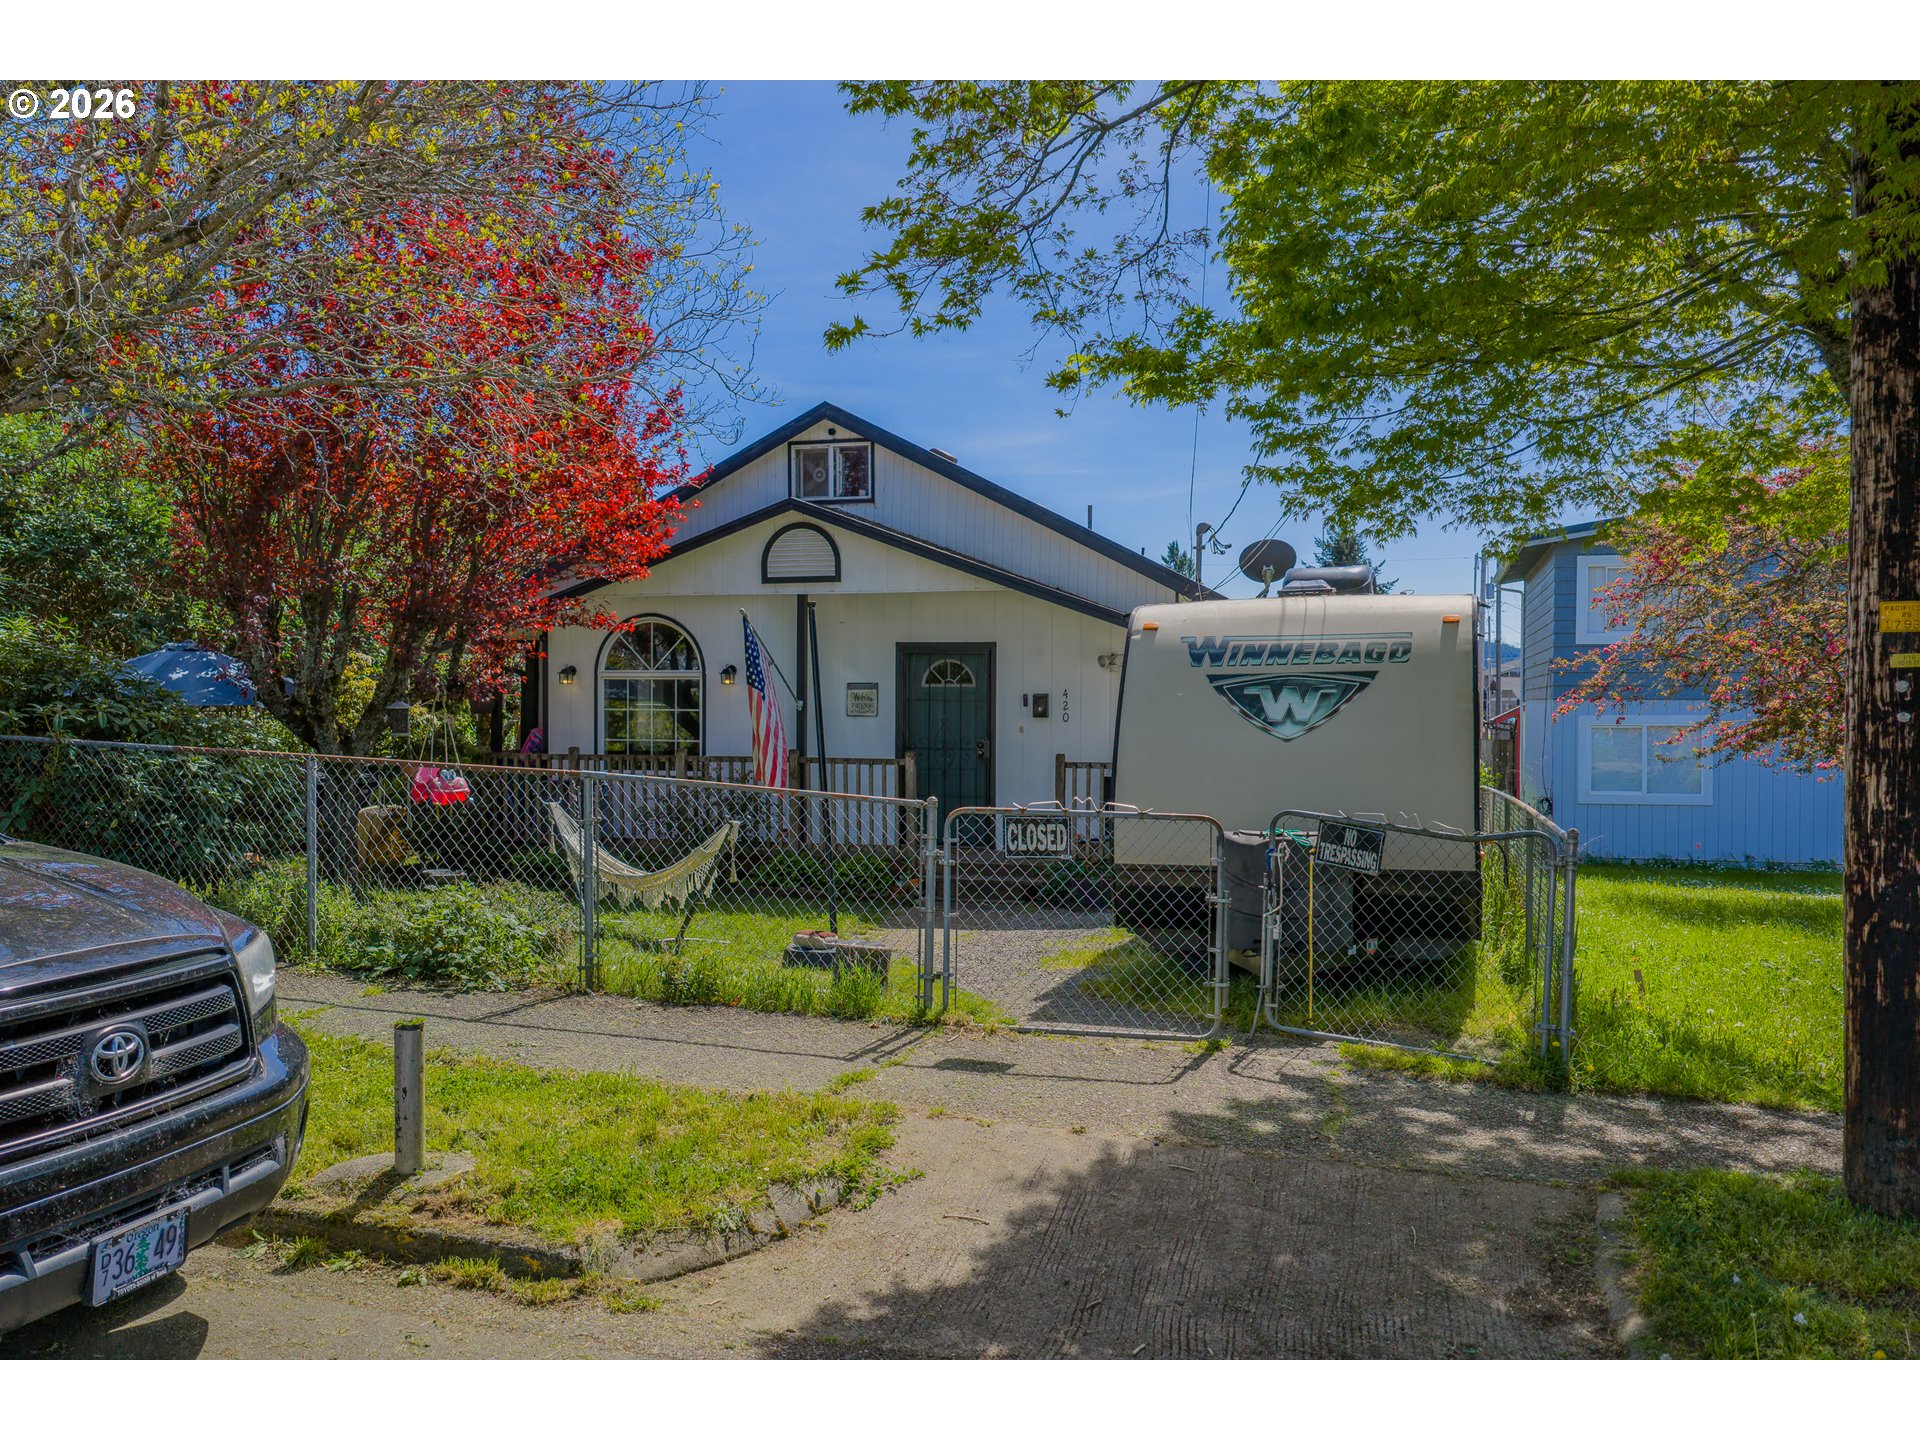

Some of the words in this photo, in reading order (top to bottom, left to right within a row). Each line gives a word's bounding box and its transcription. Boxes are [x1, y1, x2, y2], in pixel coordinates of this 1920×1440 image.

[1181, 632, 1413, 667] WINNEBAGO
[1062, 688, 1070, 723] 420
[1244, 685, 1338, 722] W
[1007, 823, 1067, 852] CLOSED
[1343, 828, 1358, 847] NO
[1319, 842, 1378, 871] TRESPASSING
[126, 1223, 160, 1243] Oregon
